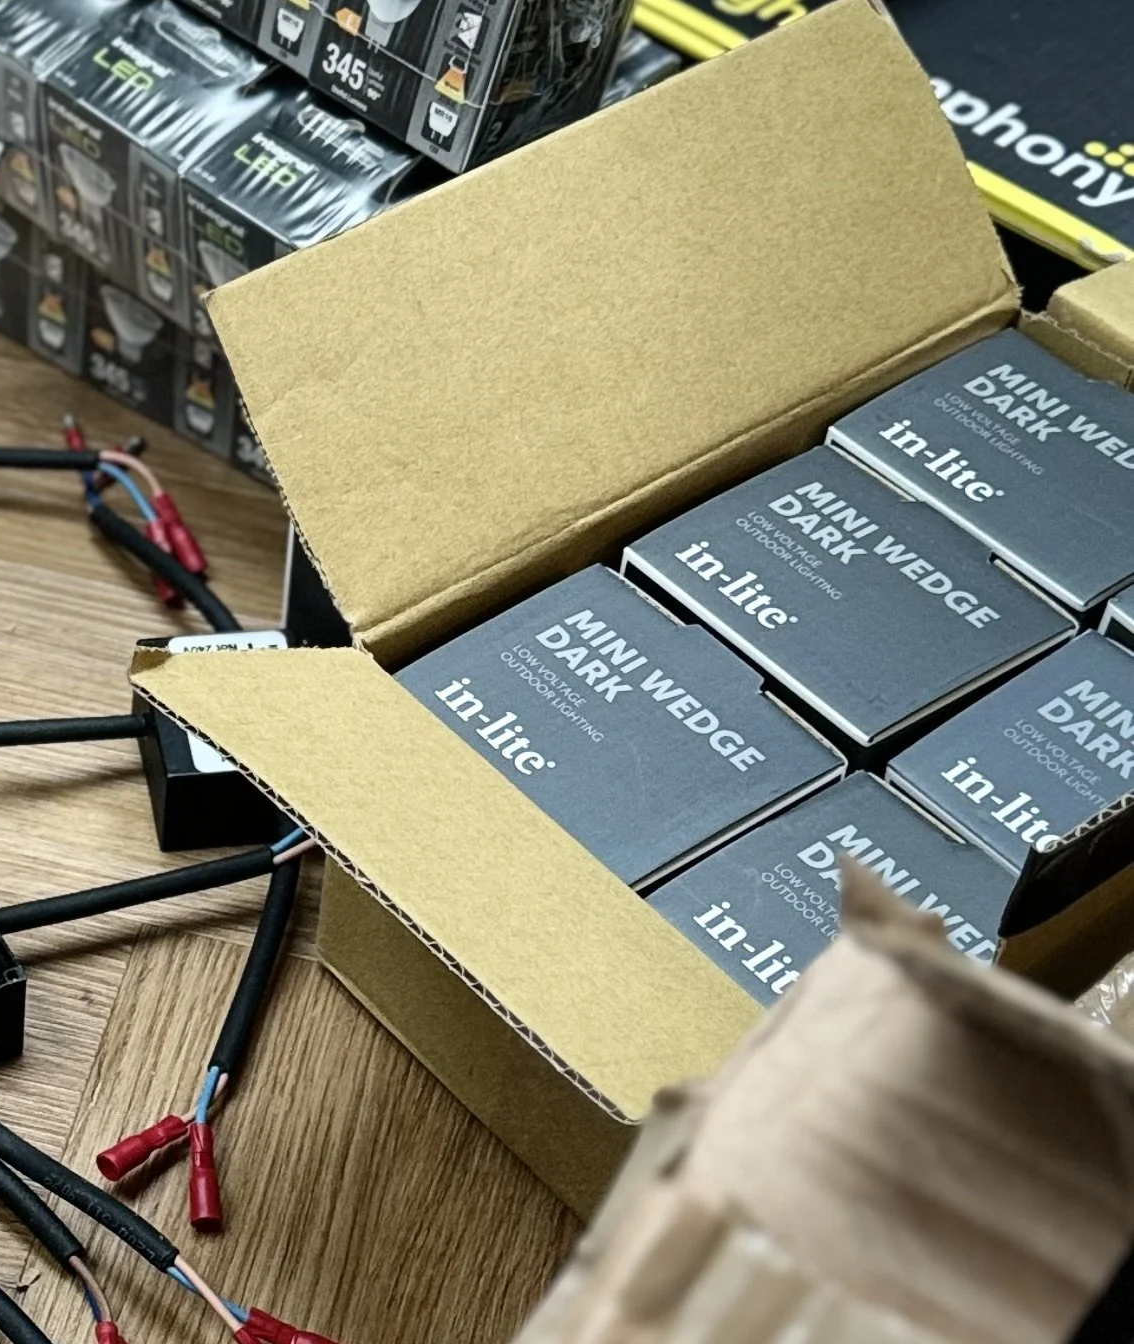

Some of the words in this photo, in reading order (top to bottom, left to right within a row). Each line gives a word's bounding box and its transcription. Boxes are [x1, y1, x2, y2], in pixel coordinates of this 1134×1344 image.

[93, 47, 155, 92] LED
[322, 42, 367, 90] 345
[944, 392, 972, 415] LOW
[971, 409, 1021, 447] VOLTAGE
[963, 376, 1062, 443] DARK
[986, 364, 1070, 418] MINI
[878, 419, 996, 503] in-lite
[934, 397, 989, 440] OUTDOOR
[988, 436, 1044, 476] LIGHTING
[735, 517, 792, 561] OUTDOOR
[788, 557, 843, 601] LIGHTING
[747, 511, 776, 536] LOW
[773, 527, 824, 568] VOLTAGE
[768, 494, 868, 565] DARK
[794, 482, 880, 539] MINI
[874, 535, 1001, 629] WEDGE
[675, 541, 789, 630] in-lite
[500, 651, 556, 701] OUTDOOR
[551, 695, 604, 744] LIGHTING
[512, 644, 540, 672] LOW
[537, 663, 587, 709] VOLTAGE
[535, 624, 634, 704] DARK
[564, 609, 648, 674] MINI
[639, 668, 767, 773] WEDGE
[434, 678, 549, 776] in-lite
[1037, 696, 1134, 780] DARK
[1064, 679, 1134, 745] MIN
[1003, 728, 1068, 779] OUTDOOR
[1015, 719, 1047, 743] LOW
[1045, 740, 1102, 786] VOLTAGE
[773, 862, 806, 889] LOW
[826, 824, 920, 897] MINI
[761, 872, 824, 926] OUTDOOR
[693, 901, 801, 995] in-lit
